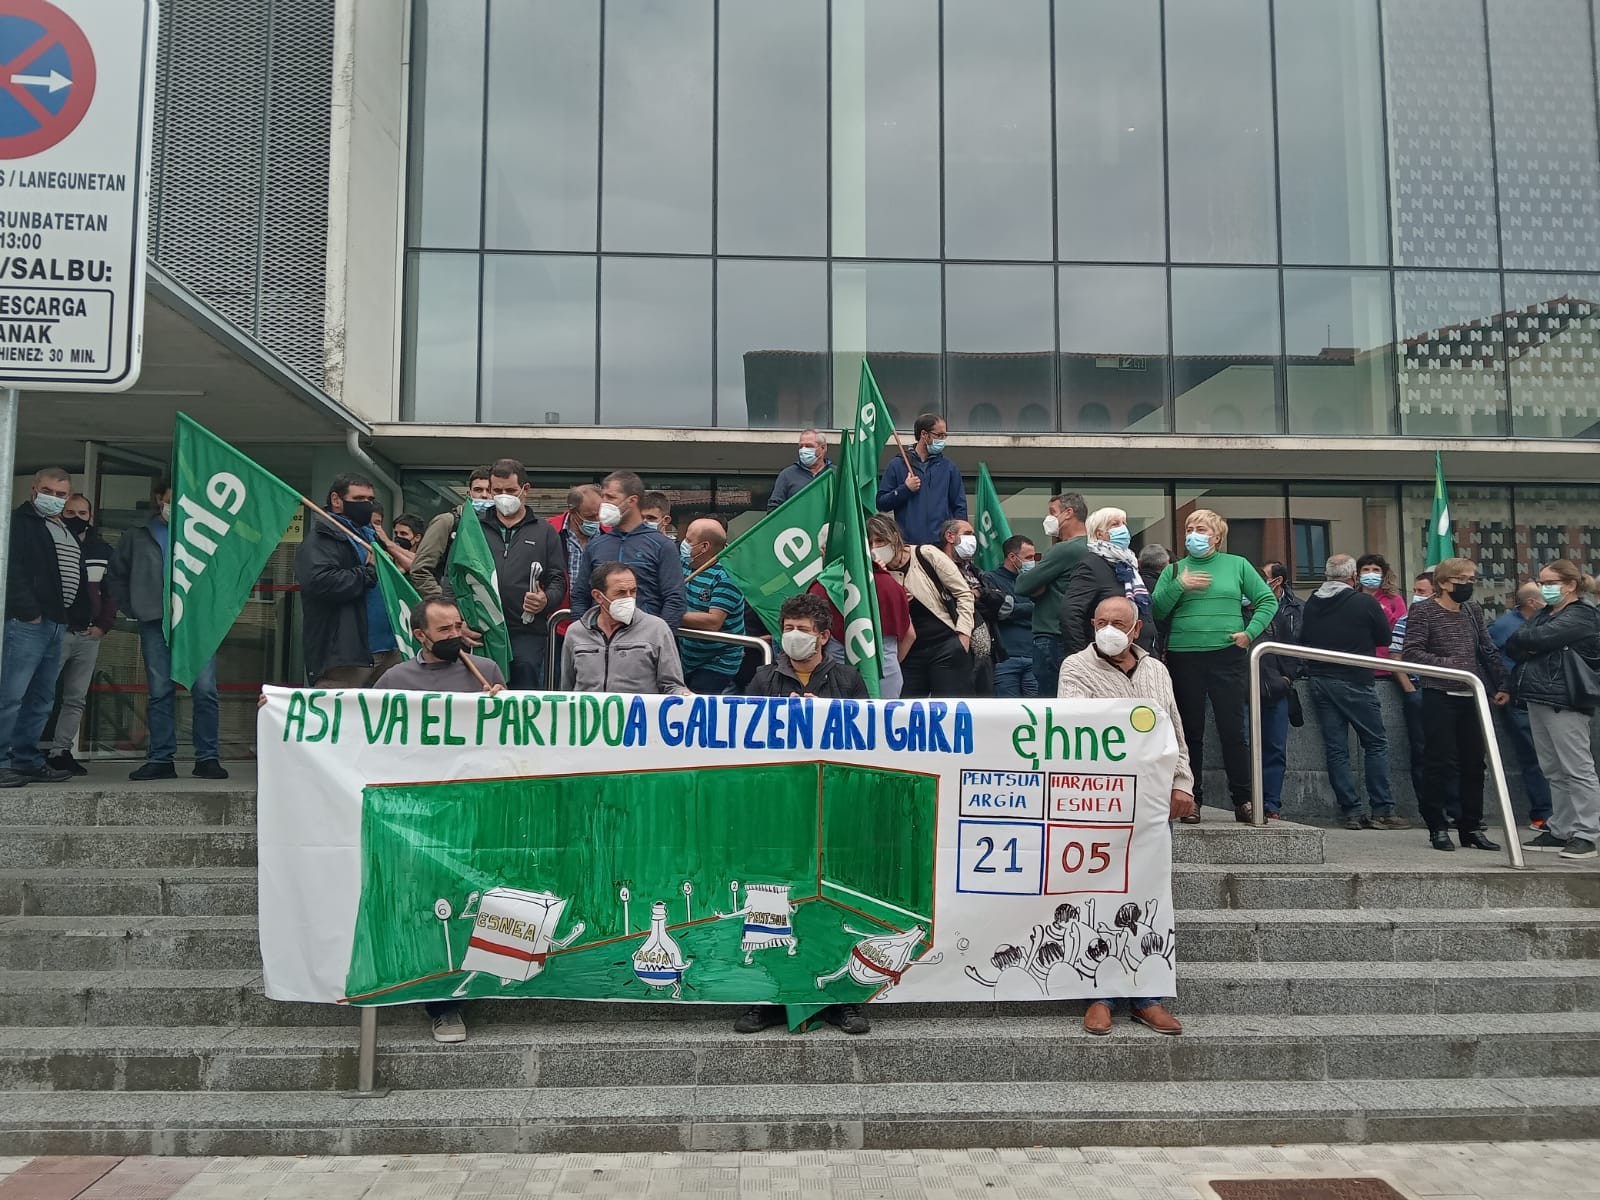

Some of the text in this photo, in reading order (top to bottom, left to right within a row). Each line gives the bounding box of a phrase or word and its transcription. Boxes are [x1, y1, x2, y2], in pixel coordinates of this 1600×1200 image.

[19, 171, 126, 191] LANEGUNETAN
[0, 295, 87, 317] ESCARGA
[49, 348, 63, 362] 30
[71, 349, 95, 363] MIN.
[358, 692, 409, 745] VA
[420, 693, 466, 746] EL
[658, 696, 814, 749] GALTZEN
[820, 699, 876, 751] ARI
[883, 700, 974, 754] GARA
[963, 772, 1040, 787] PENTSUA
[1051, 775, 1124, 792] HARAGIA
[968, 792, 1027, 809] ARGIA
[1056, 797, 1122, 813] ESNEA
[973, 836, 1023, 873] 21
[1061, 841, 1111, 874] 05
[437, 902, 447, 916] 6
[477, 911, 536, 942] ESNEA
